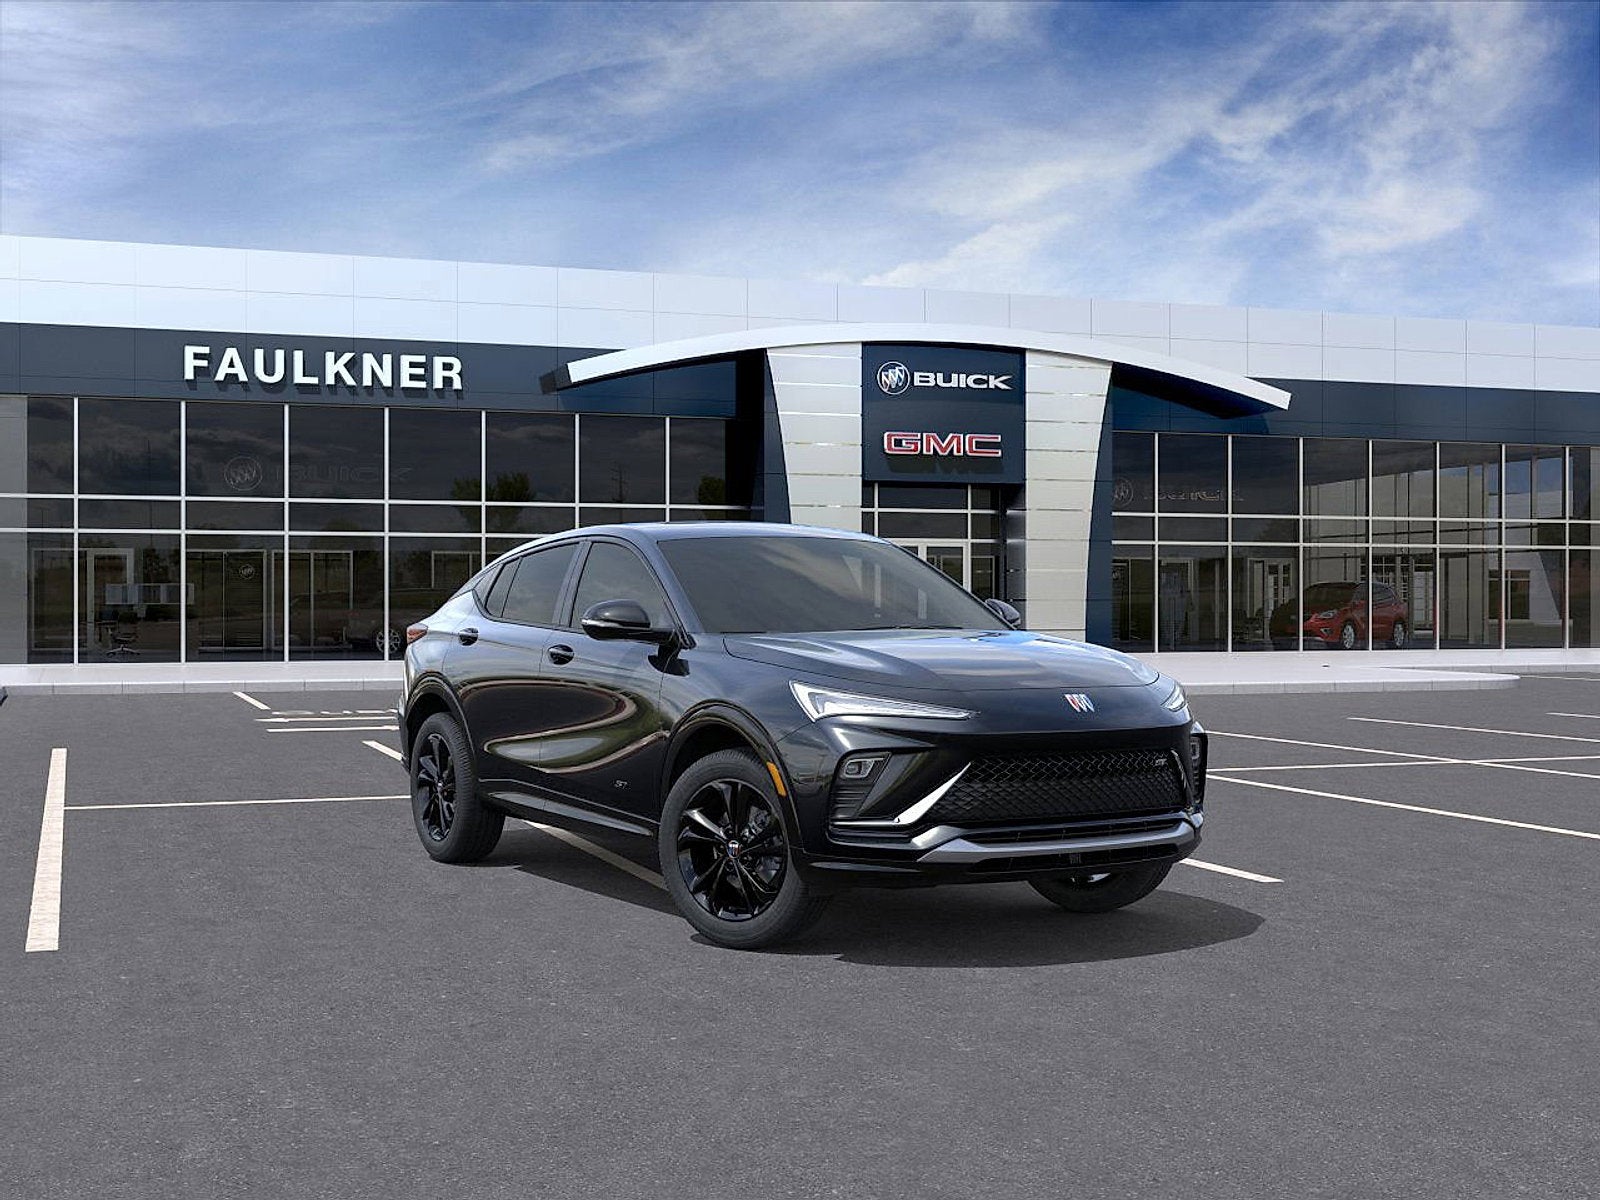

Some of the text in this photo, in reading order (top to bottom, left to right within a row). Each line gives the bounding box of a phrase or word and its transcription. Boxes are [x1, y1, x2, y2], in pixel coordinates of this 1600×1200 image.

[184, 345, 463, 390] FAULKNER
[913, 371, 1013, 390] BUICK
[883, 431, 1002, 457] GMC
